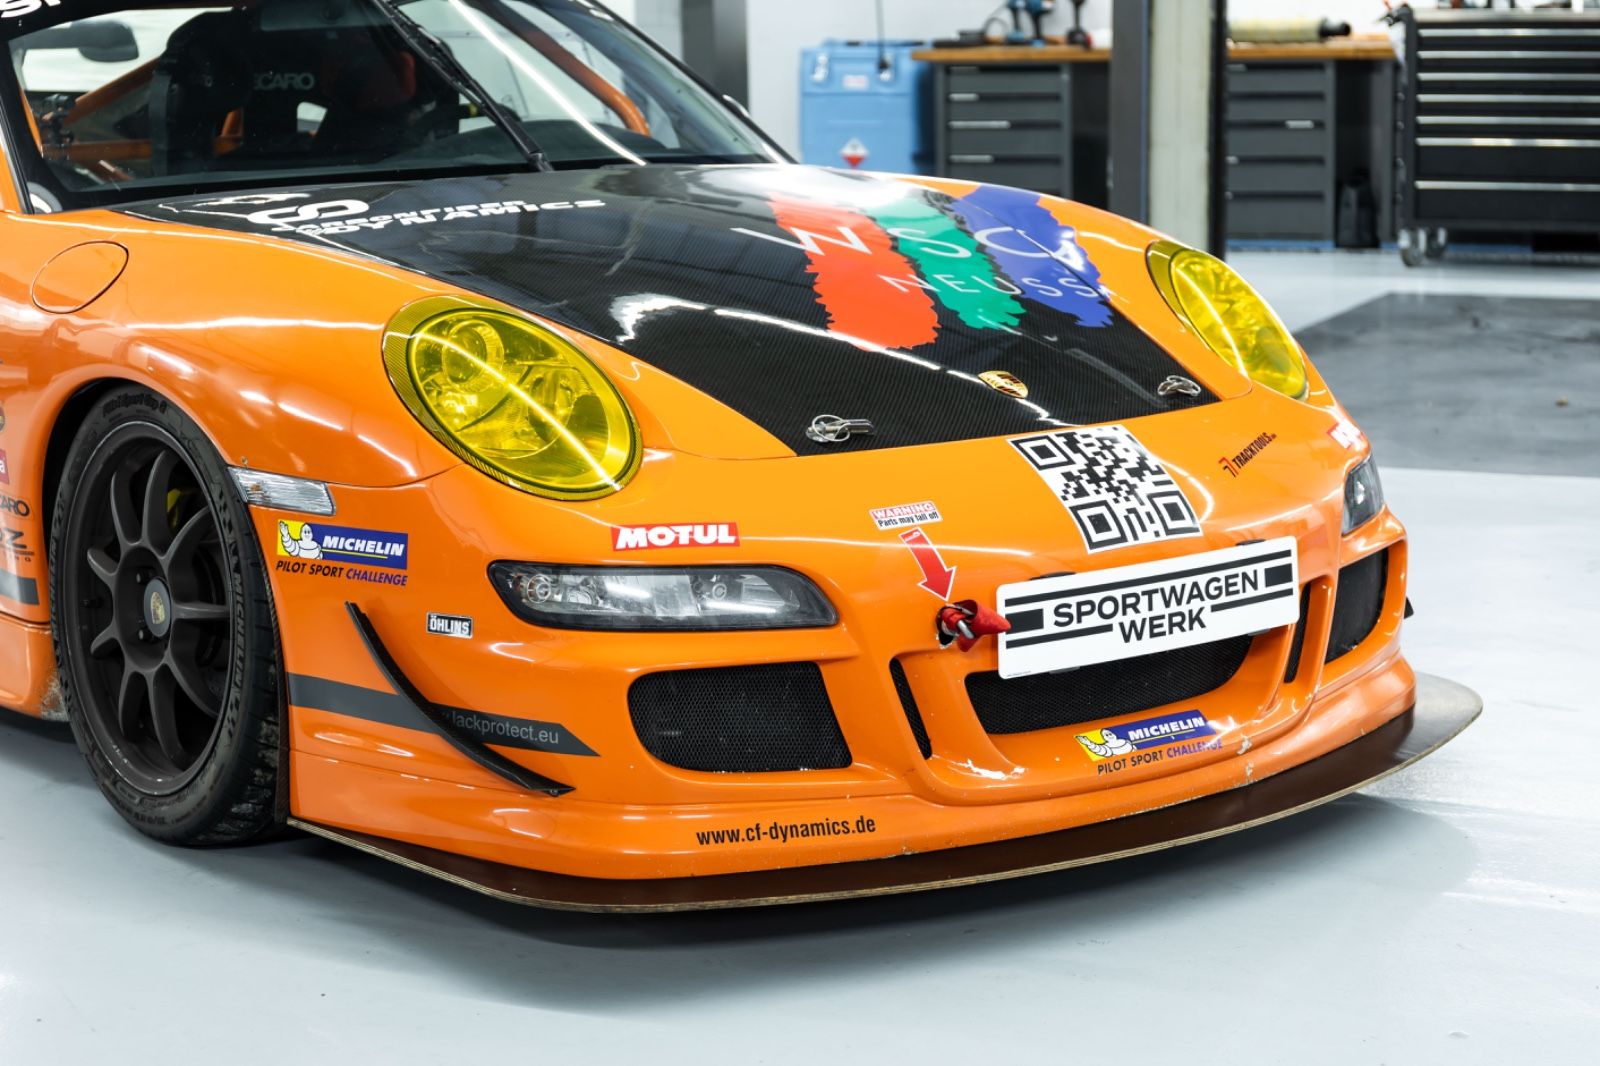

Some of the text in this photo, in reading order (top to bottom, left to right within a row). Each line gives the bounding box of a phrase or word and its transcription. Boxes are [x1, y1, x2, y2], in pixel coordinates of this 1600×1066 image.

[878, 273, 1099, 298] NEUSS
[873, 502, 935, 519] WARNING
[878, 518, 898, 527] Parts
[899, 515, 915, 524] may
[322, 535, 405, 557] MICHELIN
[616, 523, 736, 549] MOTUL
[276, 560, 408, 586] PILOT SPORT CHALLENGE
[1053, 568, 1259, 628] SPORTWAGEN
[429, 615, 471, 635] ÖHLINS
[1118, 606, 1207, 644] WERK
[1128, 716, 1205, 741] MICHELIN
[1097, 739, 1223, 775] PILOT SPORT CHALLENGE
[696, 815, 877, 845] www.cf-dynamics.de
